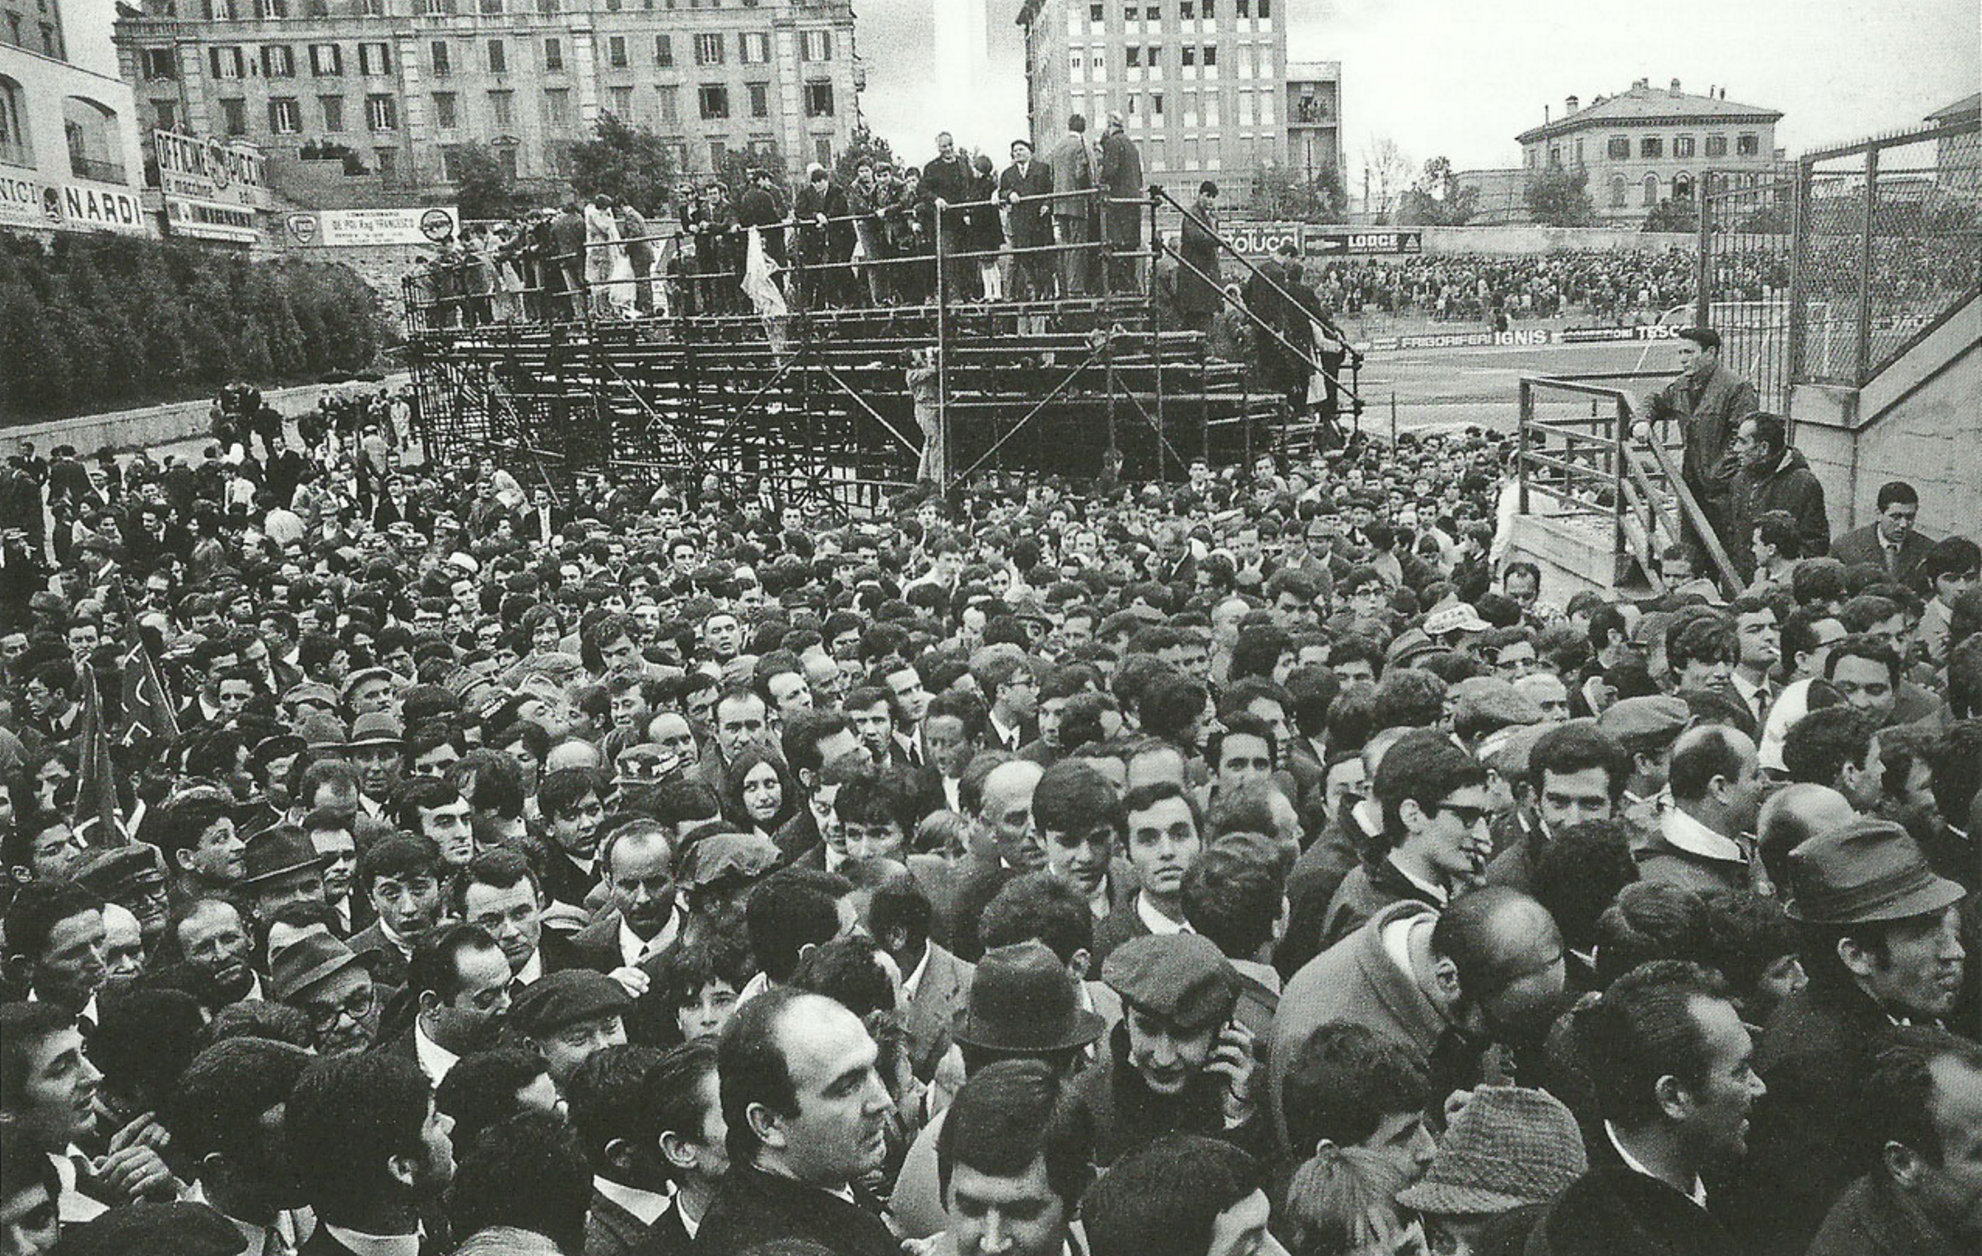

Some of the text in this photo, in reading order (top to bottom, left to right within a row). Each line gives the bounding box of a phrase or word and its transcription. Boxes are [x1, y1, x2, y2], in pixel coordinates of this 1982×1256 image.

[65, 187, 141, 225] NARDI
[1401, 334, 1492, 349] FRIGORIFERI
[1495, 329, 1548, 346] IGNIS
[1636, 324, 1692, 341] TESC
